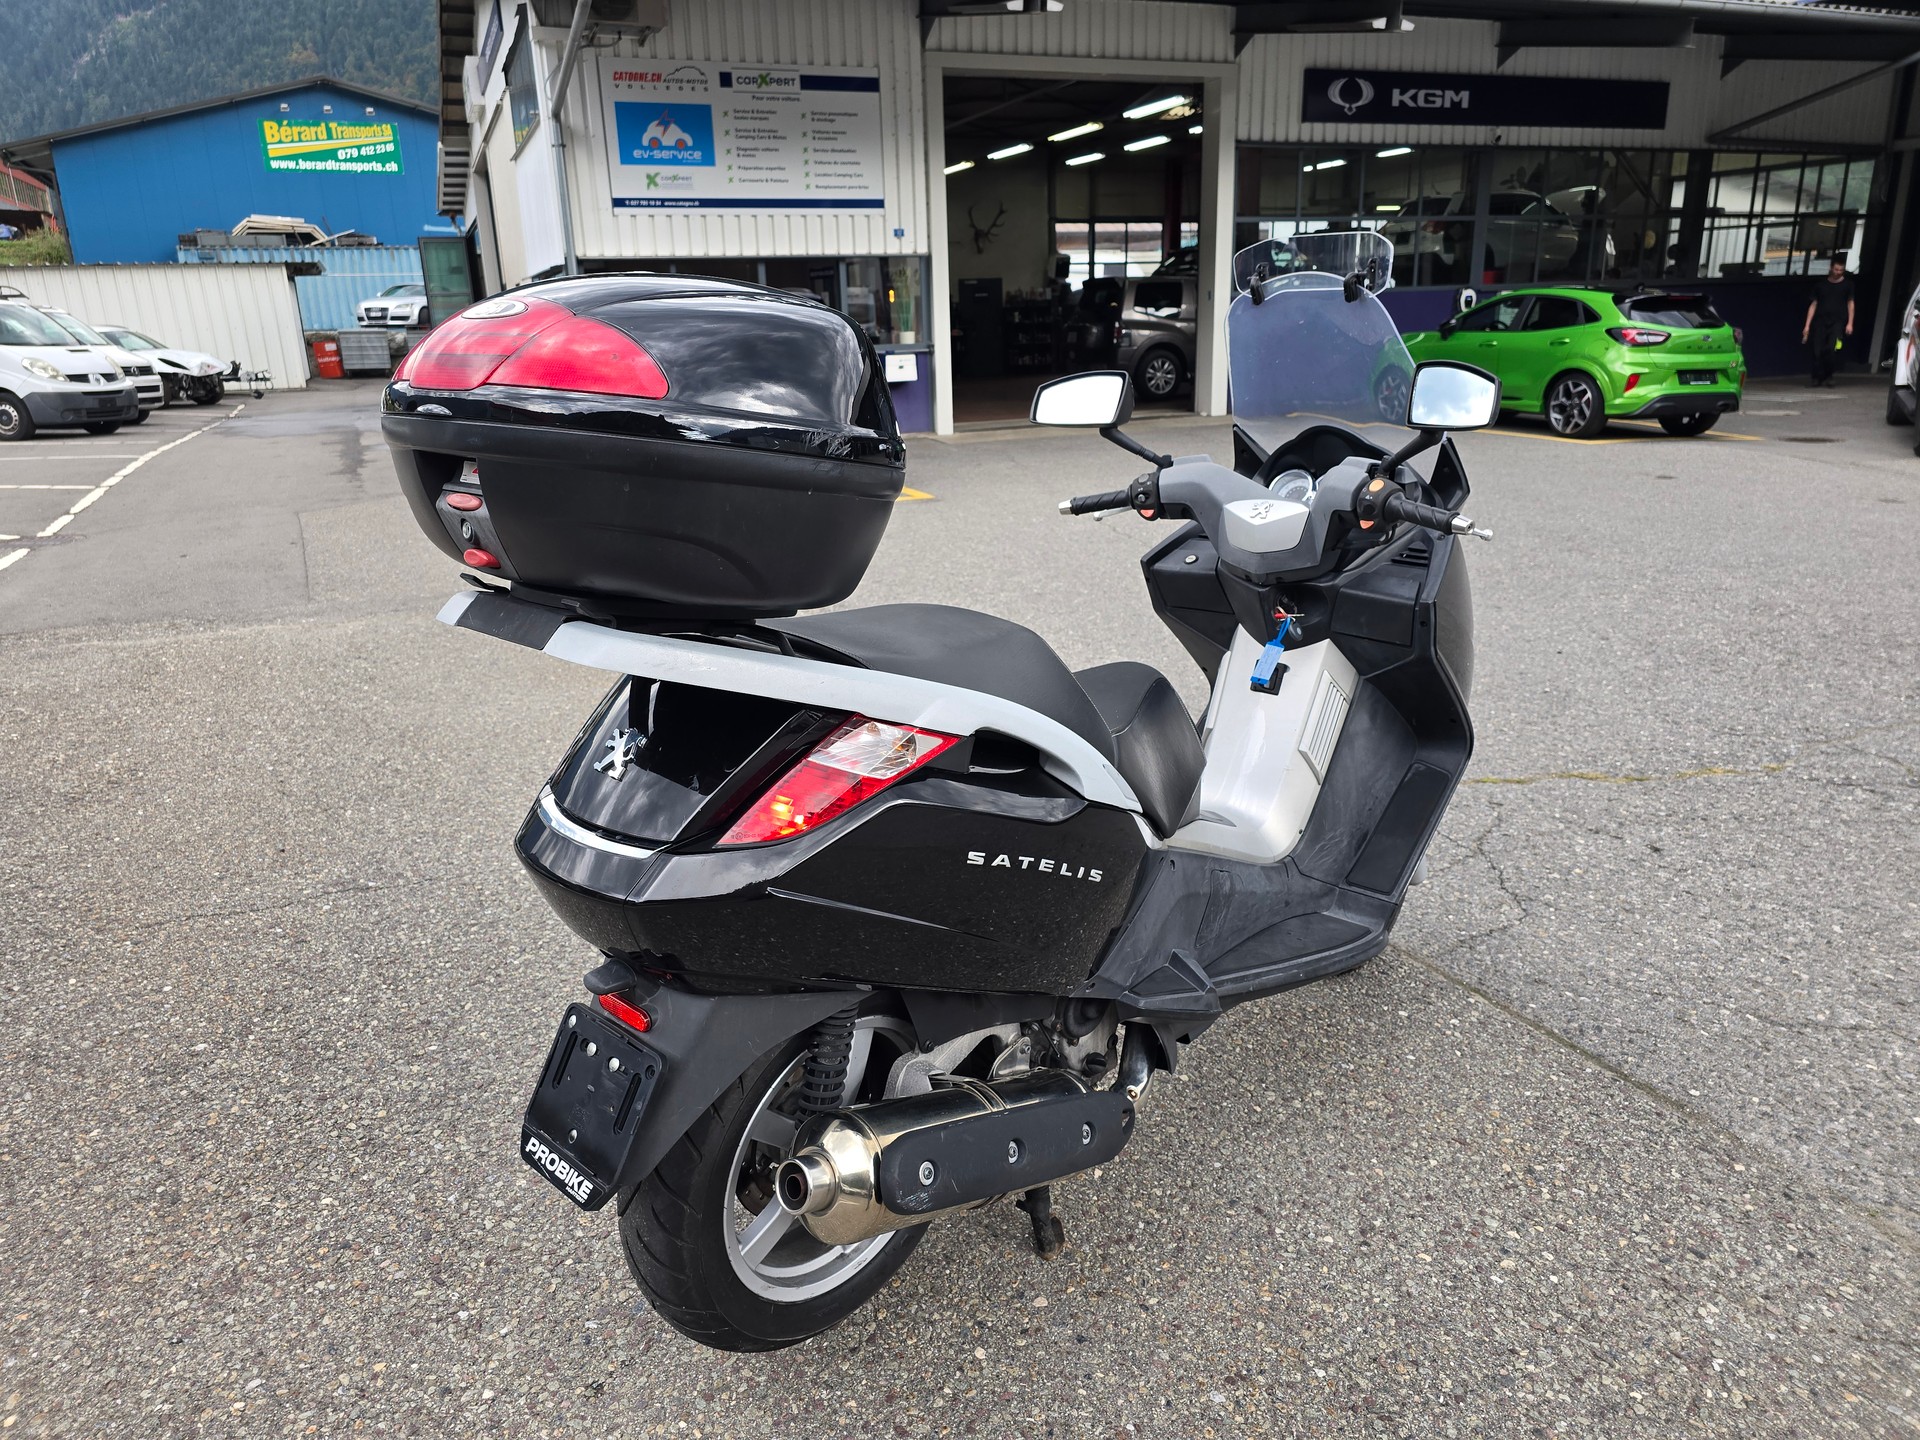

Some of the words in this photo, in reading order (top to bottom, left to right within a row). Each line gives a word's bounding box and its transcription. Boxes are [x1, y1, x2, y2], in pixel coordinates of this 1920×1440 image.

[613, 71, 662, 83] CATOGNE.CH
[1391, 88, 1470, 109] KGM
[263, 120, 327, 143] Bérard
[329, 122, 382, 139] Transports
[382, 124, 393, 137] SA
[337, 148, 358, 160] 079
[360, 146, 375, 156] 412
[376, 144, 386, 153] 23
[633, 149, 702, 160] ev-service
[270, 159, 398, 173] www.berardtransports.ch
[966, 851, 1103, 883] SATELIS
[525, 1136, 594, 1200] PROBIKE
